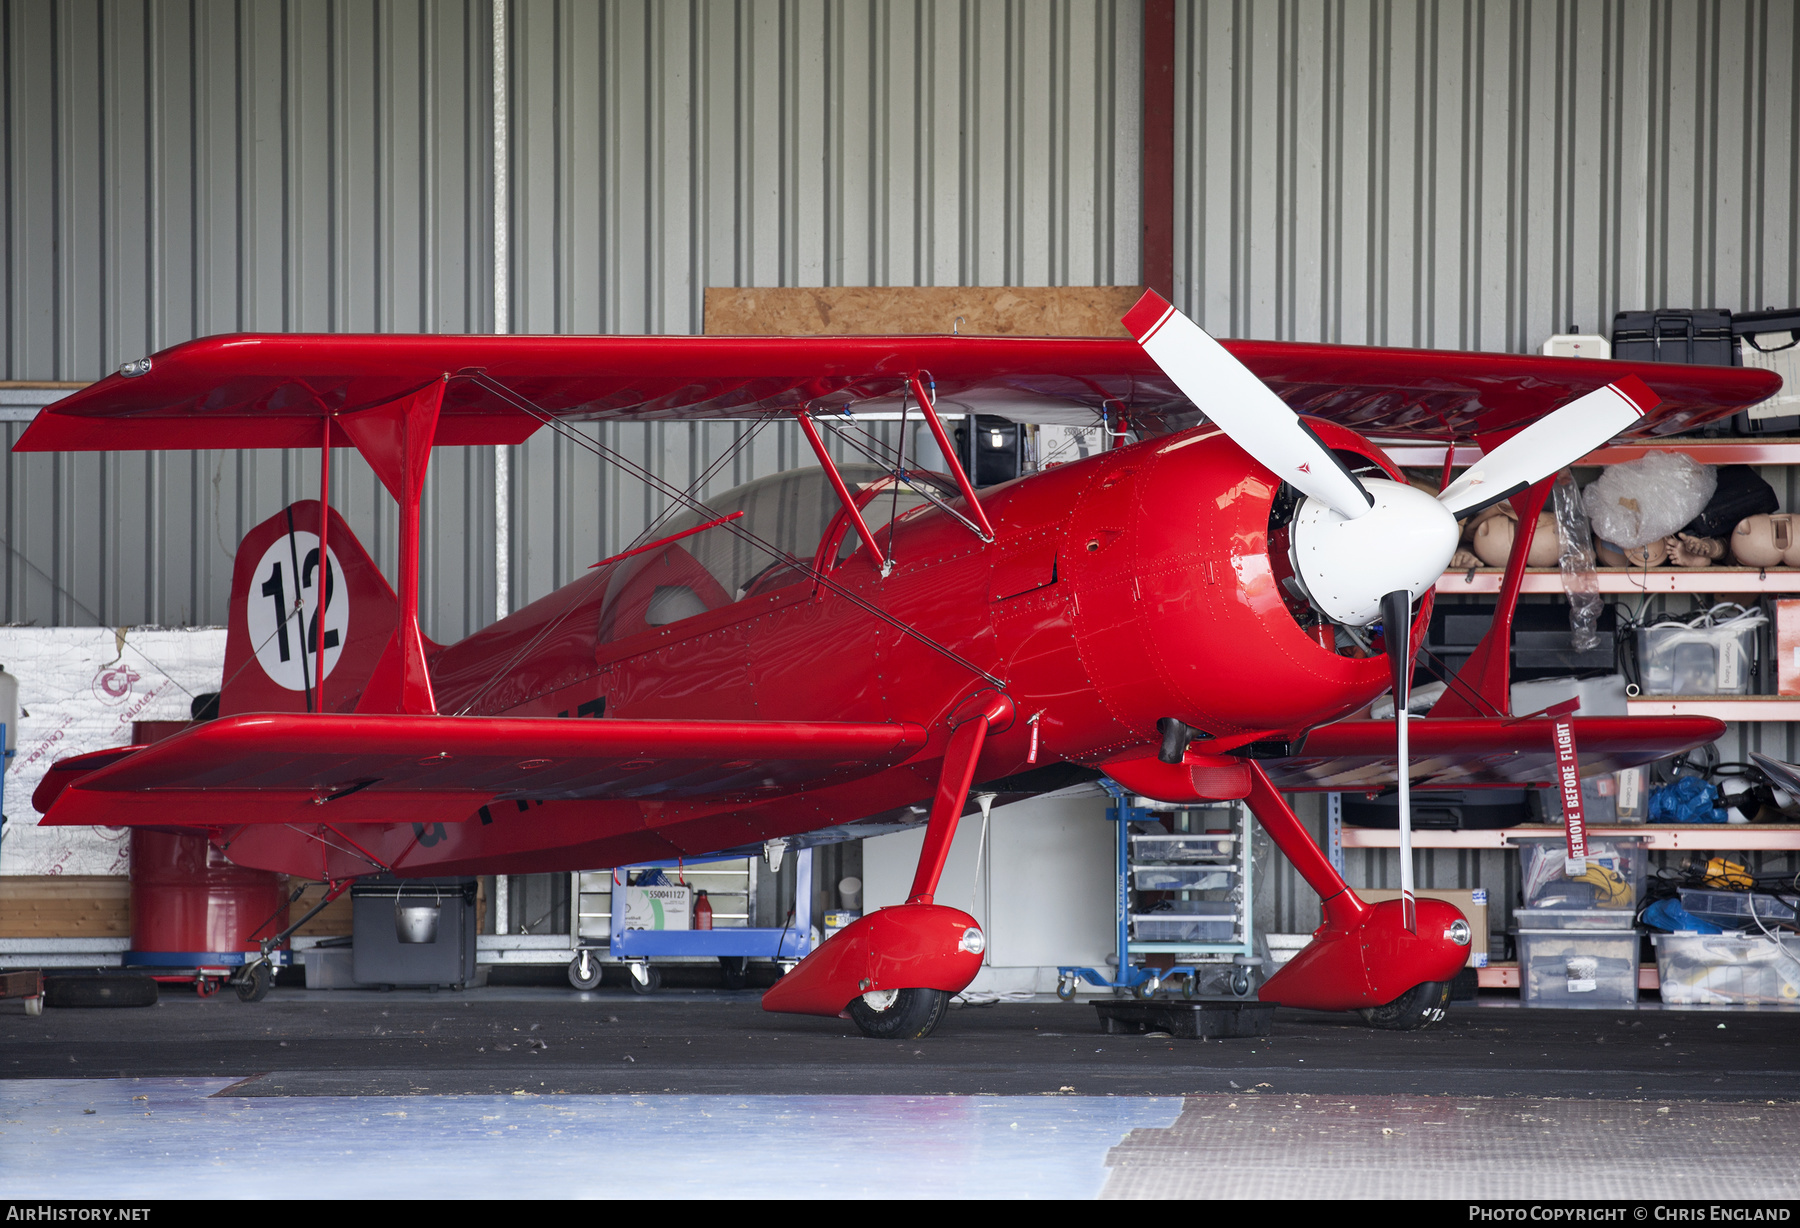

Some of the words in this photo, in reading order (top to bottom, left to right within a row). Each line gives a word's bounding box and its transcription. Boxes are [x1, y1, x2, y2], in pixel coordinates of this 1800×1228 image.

[262, 547, 339, 663] 12
[1556, 723, 1573, 761] FLIGHT
[1562, 765, 1579, 808] BEFORE
[1570, 812, 1585, 859] REMOVE
[649, 890, 685, 899] 550041127
